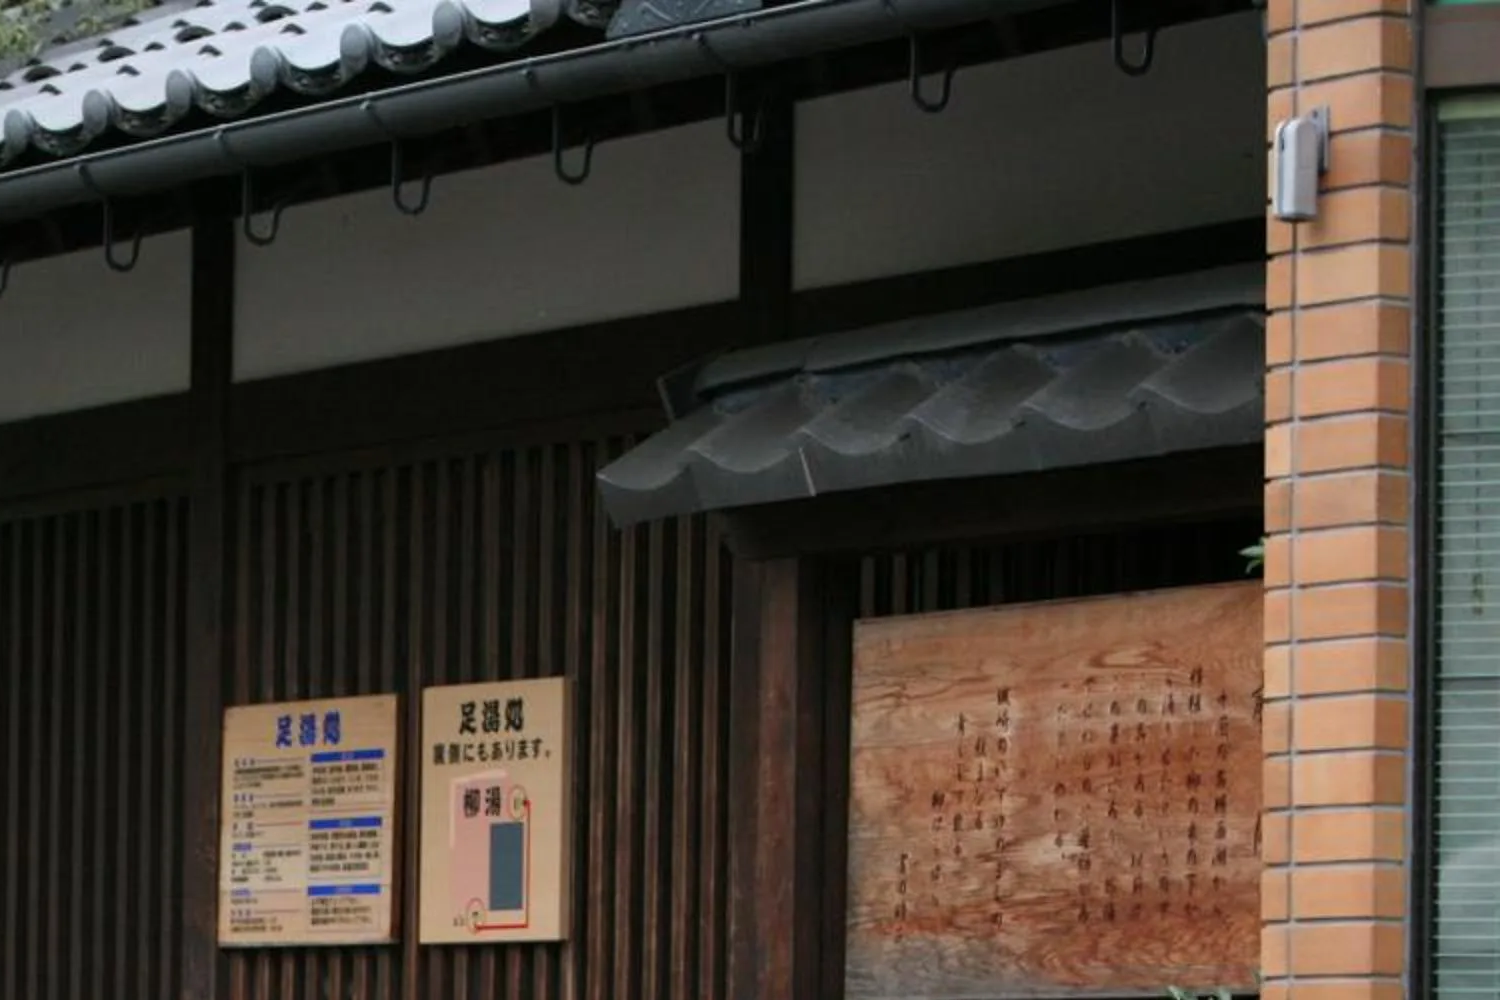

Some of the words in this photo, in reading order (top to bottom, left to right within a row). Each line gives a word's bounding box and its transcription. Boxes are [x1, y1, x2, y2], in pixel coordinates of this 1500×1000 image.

[459, 697, 524, 735] 足湯処
[463, 785, 501, 817] 柳湯
